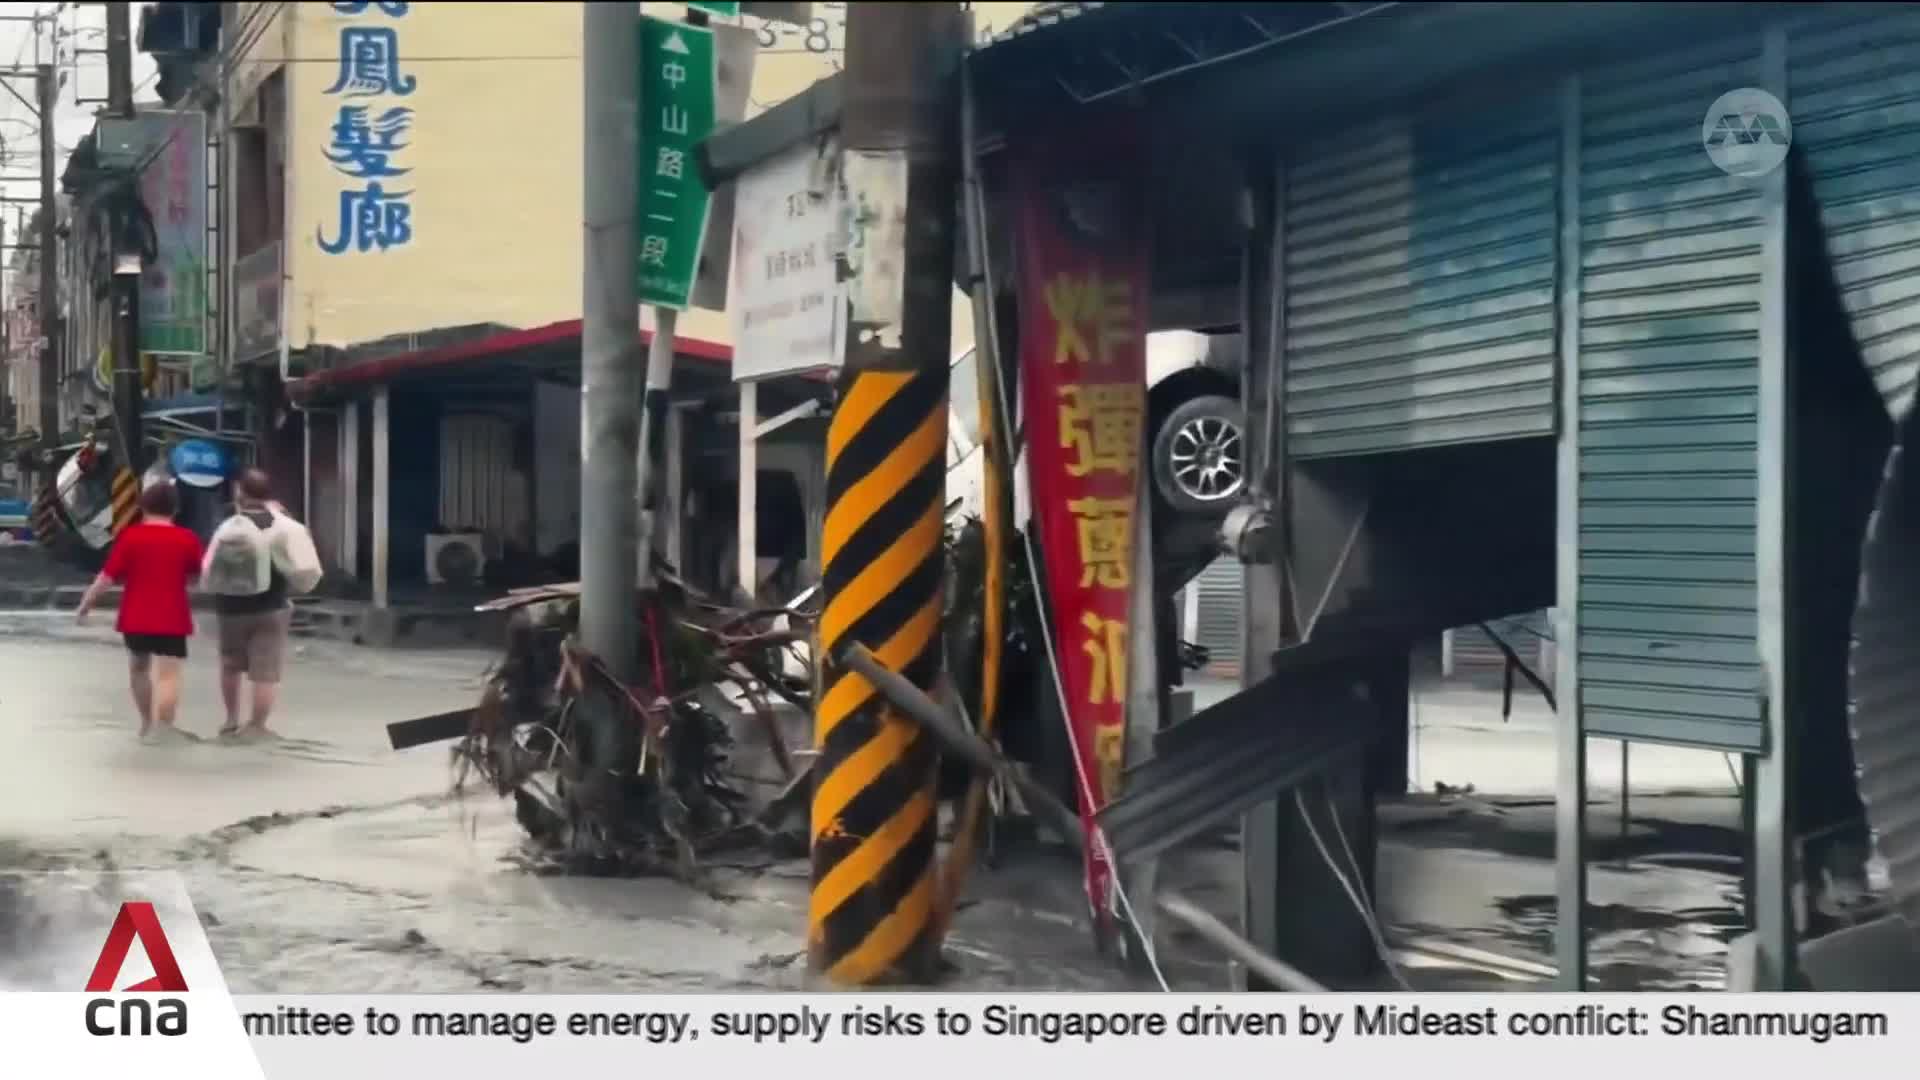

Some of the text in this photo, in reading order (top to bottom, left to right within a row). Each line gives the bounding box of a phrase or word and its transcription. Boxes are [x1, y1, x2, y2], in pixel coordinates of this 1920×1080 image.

[317, 2, 417, 255] 鳳髮廊
[639, 61, 689, 268] 中山路二段
